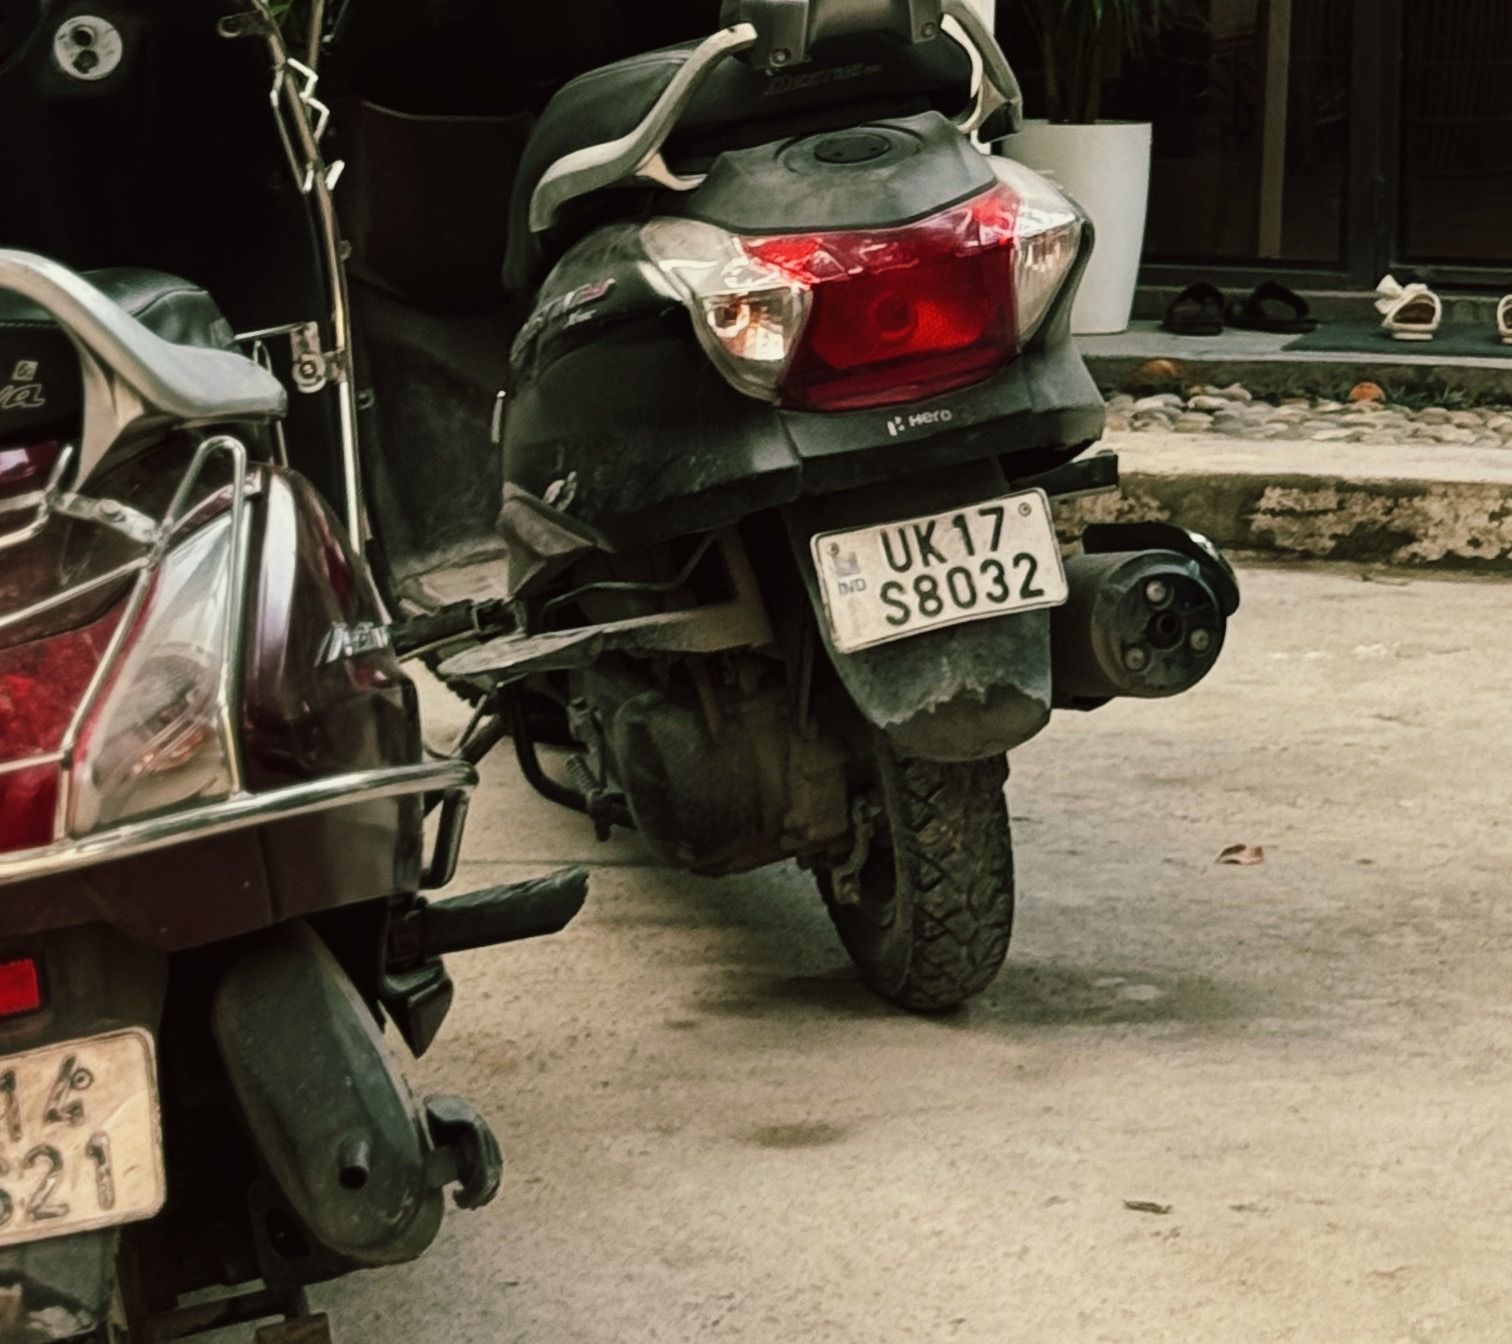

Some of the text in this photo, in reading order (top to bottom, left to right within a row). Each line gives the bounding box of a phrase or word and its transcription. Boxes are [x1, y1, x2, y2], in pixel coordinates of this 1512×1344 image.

[908, 409, 952, 427] Hero
[880, 505, 1005, 574] UK17
[879, 552, 1045, 626] S8032
